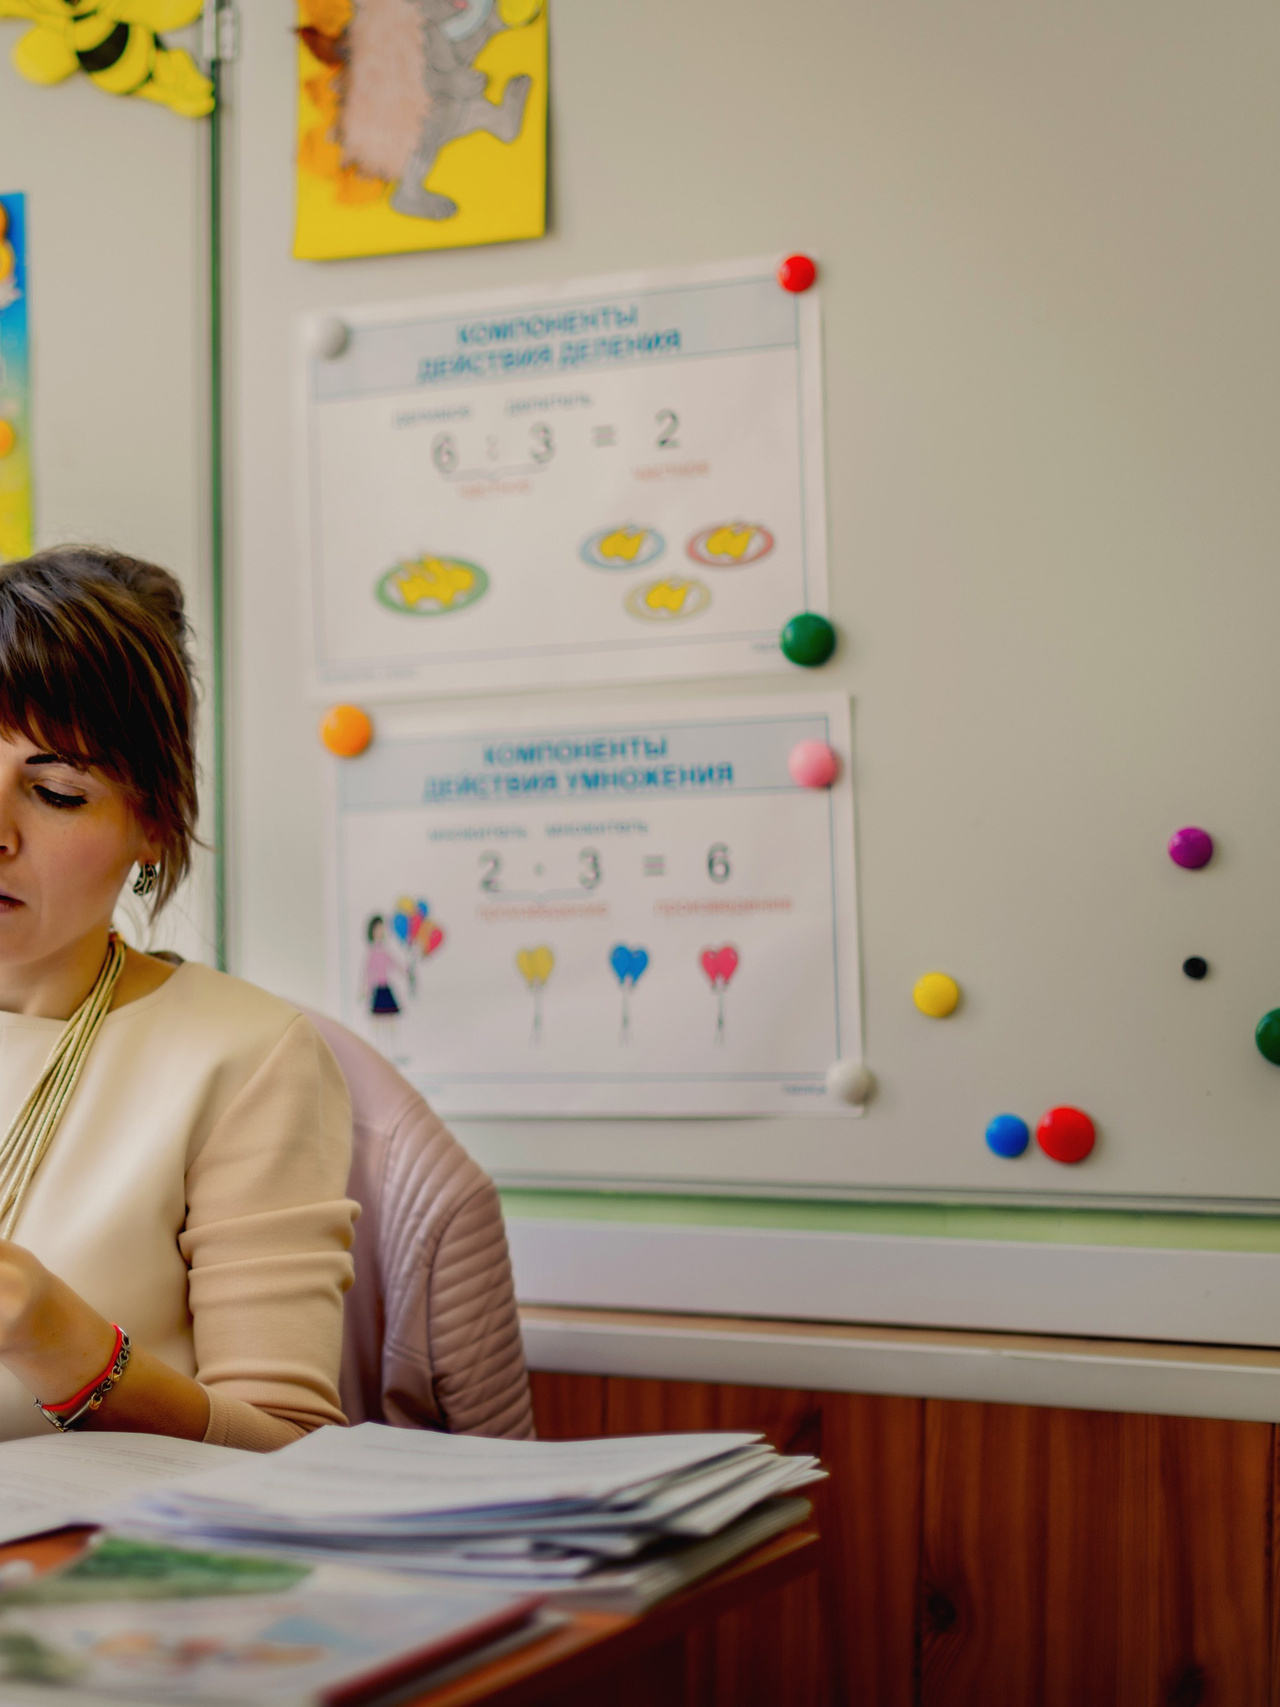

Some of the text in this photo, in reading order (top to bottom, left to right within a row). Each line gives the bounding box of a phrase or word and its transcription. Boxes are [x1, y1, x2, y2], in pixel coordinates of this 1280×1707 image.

[456, 304, 639, 346] КОМПОНЕНТЫ
[417, 328, 682, 384] ДЕЙСТВИЯ ДЕЛЕНИЯ
[432, 431, 459, 475] 6
[529, 421, 556, 464] 3
[655, 408, 681, 449] 2
[482, 737, 668, 767] КОМПОНЕНТЫ
[424, 763, 734, 803] ДЕЙСТВИЯ УМНОЖЕНИЯ
[478, 849, 504, 894] 2
[578, 846, 604, 891] 3
[705, 842, 732, 884] 6
